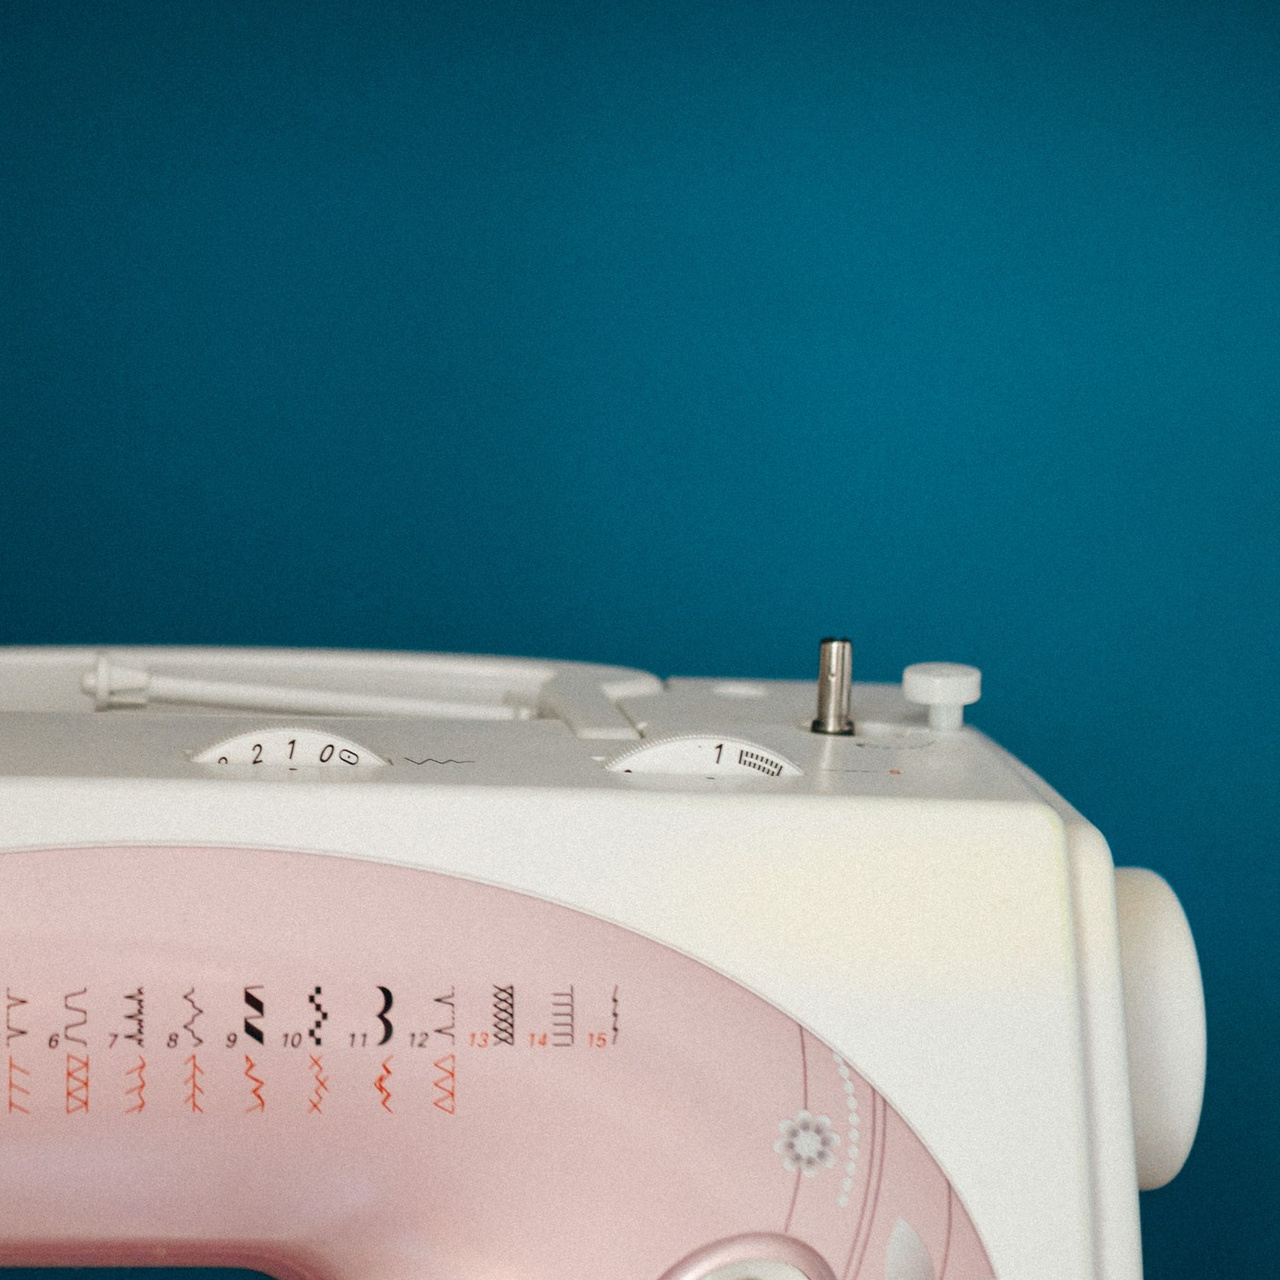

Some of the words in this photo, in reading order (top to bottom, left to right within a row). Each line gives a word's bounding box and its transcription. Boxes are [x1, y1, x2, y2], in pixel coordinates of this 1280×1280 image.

[251, 743, 263, 765] 2
[287, 739, 296, 760] 1
[319, 743, 335, 763] 0
[714, 743, 724, 764] 1
[47, 1033, 60, 1050] 6
[108, 1032, 119, 1049] 7
[166, 1032, 179, 1049] 8
[225, 1032, 238, 1049] 9
[282, 1032, 303, 1049] 10
[349, 1032, 368, 1048] 11
[409, 1032, 430, 1049] 12
[469, 1032, 490, 1048] 13
[529, 1032, 548, 1048] 14
[588, 1032, 607, 1048] 15
